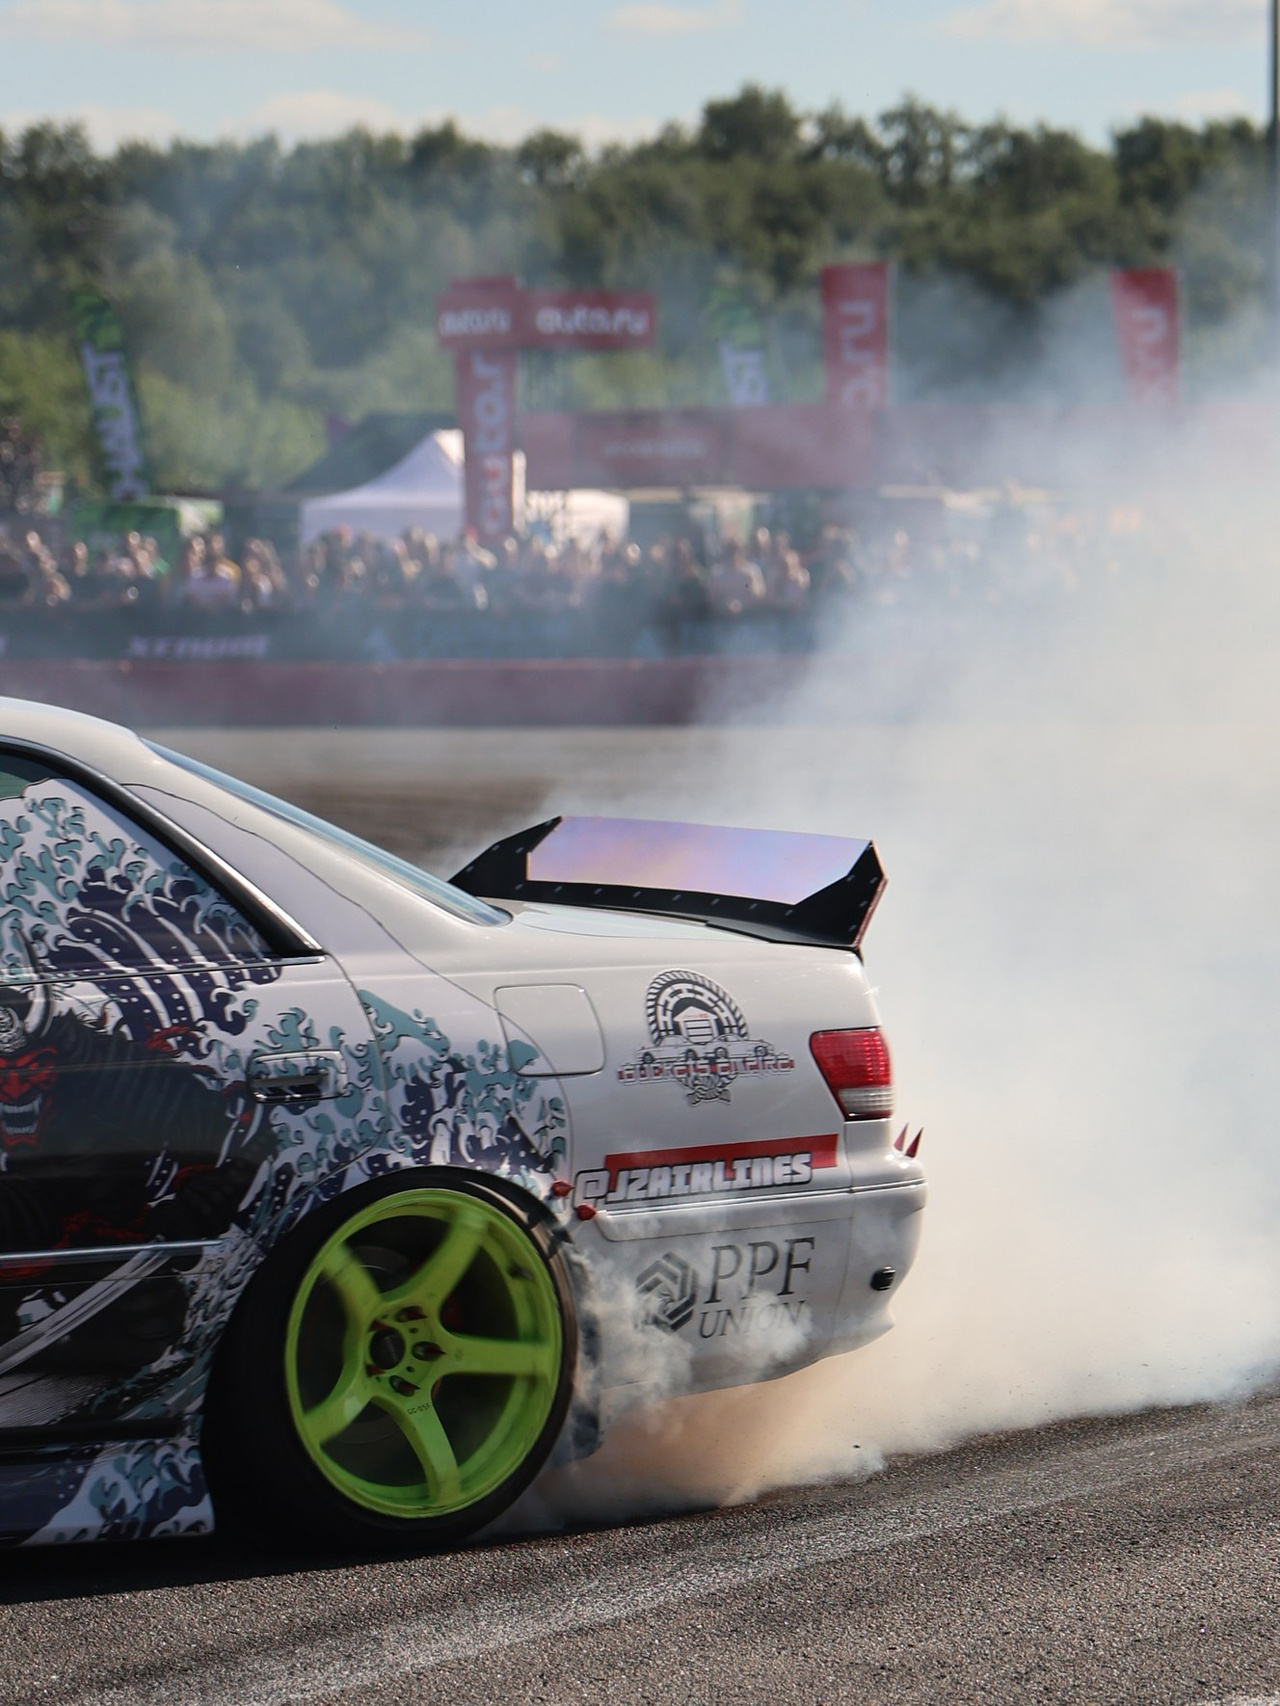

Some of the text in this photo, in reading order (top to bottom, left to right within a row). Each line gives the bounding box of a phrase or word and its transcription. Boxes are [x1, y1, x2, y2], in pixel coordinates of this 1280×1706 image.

[536, 306, 650, 335] auto.ru
[705, 1237, 815, 1304] PPF
[699, 1300, 806, 1338] UNION
